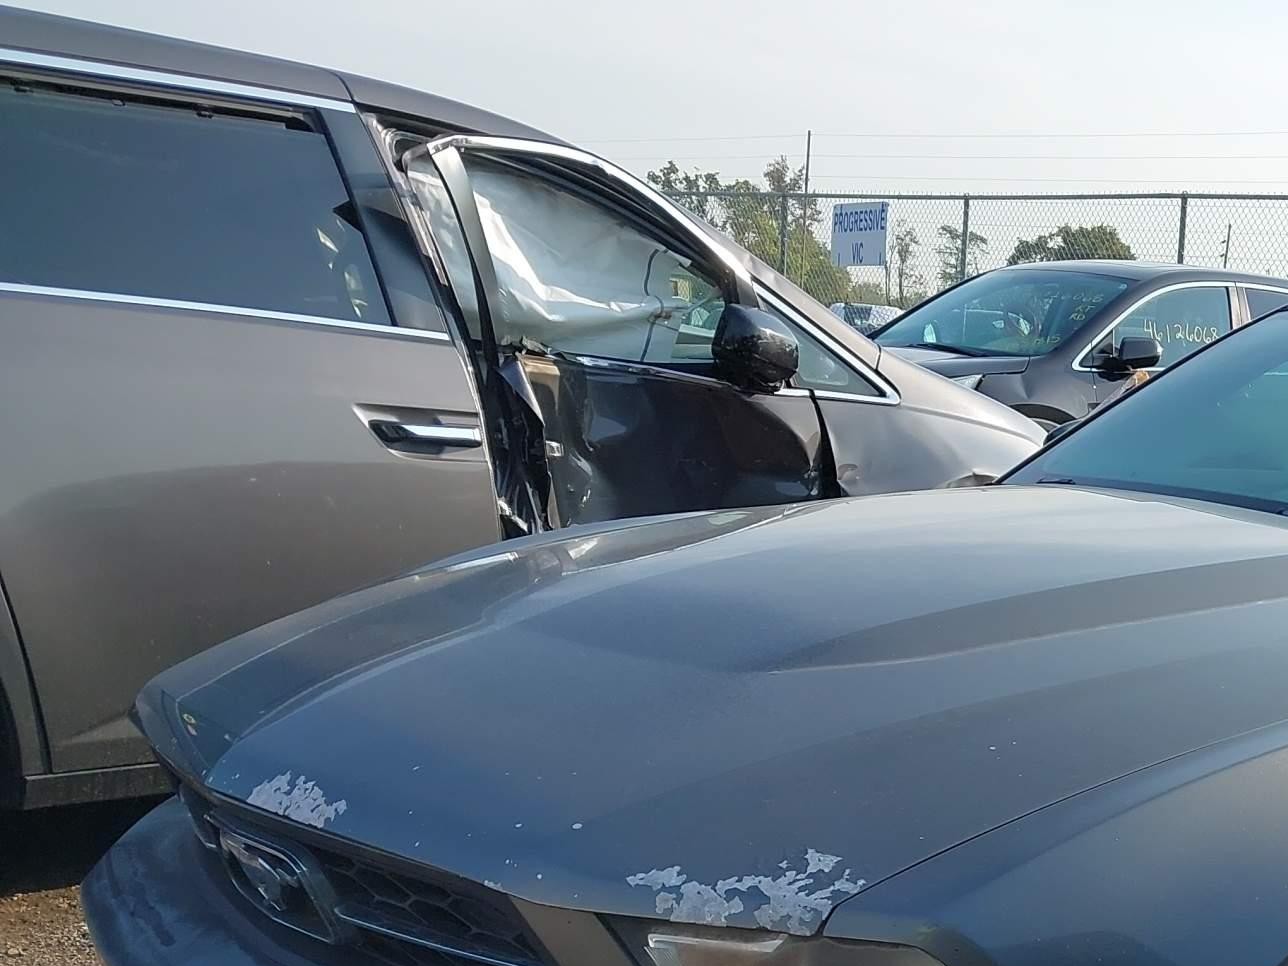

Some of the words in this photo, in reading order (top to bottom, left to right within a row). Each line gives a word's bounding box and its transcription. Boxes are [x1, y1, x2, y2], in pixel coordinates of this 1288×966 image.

[833, 208, 886, 233] PROGRESSIVE
[851, 241, 864, 264] VIC
[1143, 319, 1220, 344] 46126068
